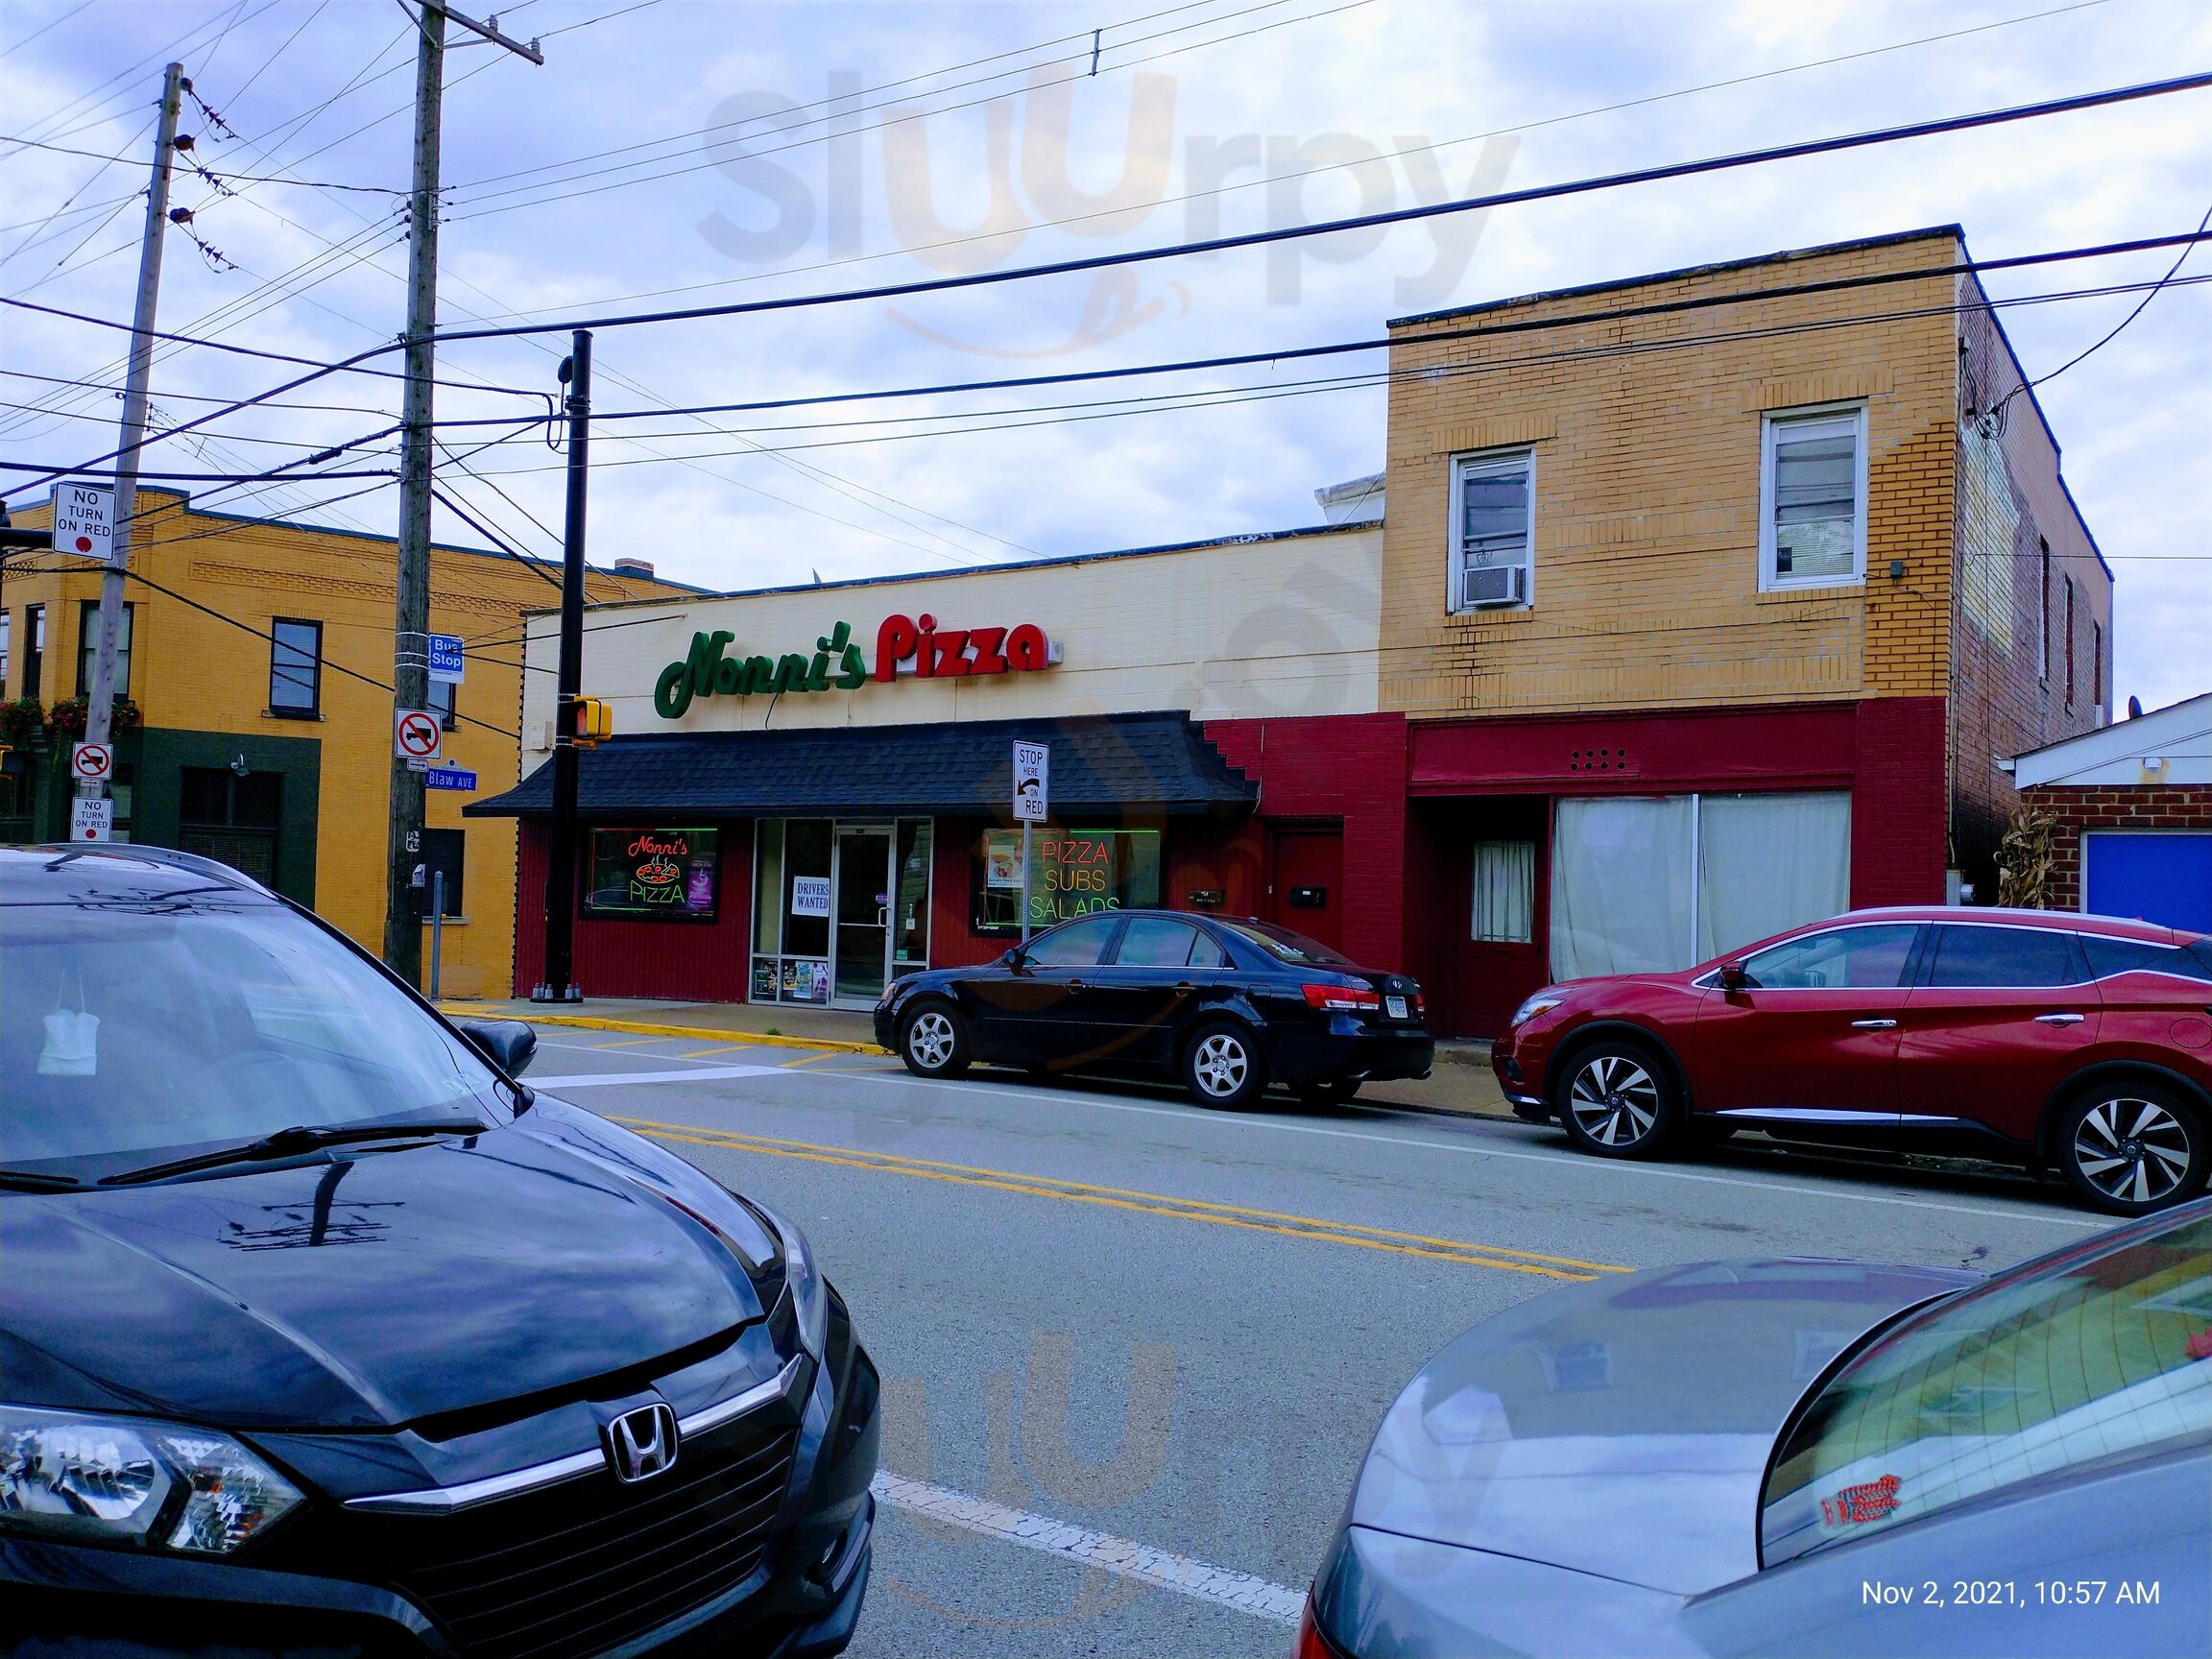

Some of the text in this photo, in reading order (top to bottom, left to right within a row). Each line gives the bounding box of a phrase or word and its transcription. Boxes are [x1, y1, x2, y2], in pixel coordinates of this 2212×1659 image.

[74, 489, 99, 505] NO
[68, 505, 103, 521] TURN
[59, 518, 110, 537] ON RED
[432, 653, 461, 668] Stop
[654, 613, 1048, 719] Nonni's Pizza
[1019, 749, 1044, 765] STOP
[428, 771, 472, 788] Blaw AVE
[1022, 767, 1039, 777] HERE
[1029, 788, 1039, 797] ON
[84, 801, 102, 810] NO
[1025, 800, 1044, 814] RED
[75, 819, 108, 829] ON RED
[628, 835, 687, 857] Nonni's
[1041, 841, 1110, 864] PIZZA
[1045, 869, 1106, 891] SUBS
[630, 879, 685, 903] PIZZA
[797, 882, 830, 896] DRIVERS
[797, 897, 829, 909] WANTED
[1029, 897, 1120, 919] SALADS
